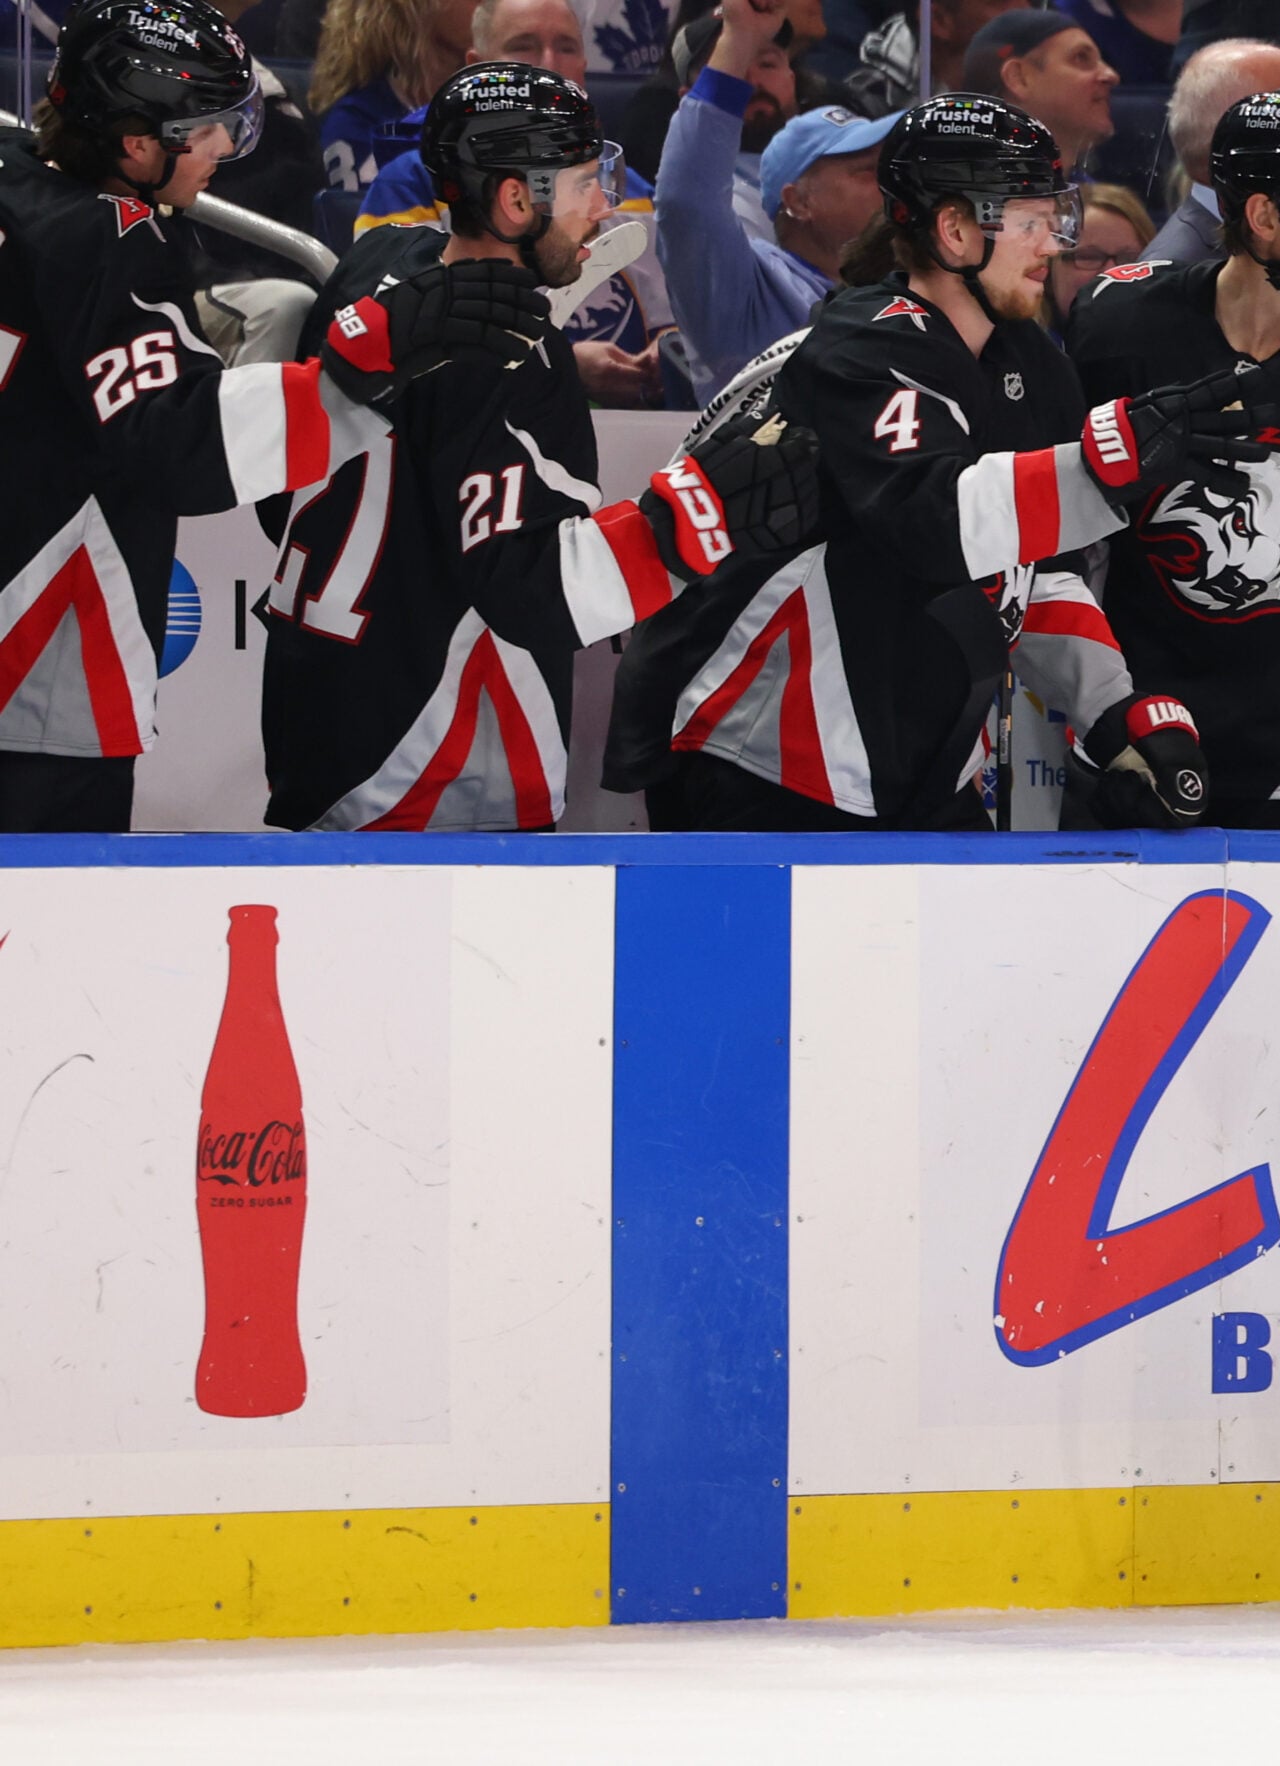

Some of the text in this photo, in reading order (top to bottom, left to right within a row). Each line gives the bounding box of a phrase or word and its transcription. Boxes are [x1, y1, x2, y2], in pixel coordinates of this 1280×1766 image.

[128, 9, 201, 50] Trusted
[139, 31, 179, 53] talent
[460, 83, 531, 100] Trusted
[474, 98, 514, 112] talent
[924, 109, 994, 125] Trusted
[1245, 117, 1279, 130] talent
[937, 122, 977, 135] talent
[83, 329, 179, 424] 25
[873, 388, 922, 454] 4
[458, 462, 525, 553] 21
[1026, 760, 1068, 787] The
[210, 1196, 293, 1208] ZERO SUGAR
